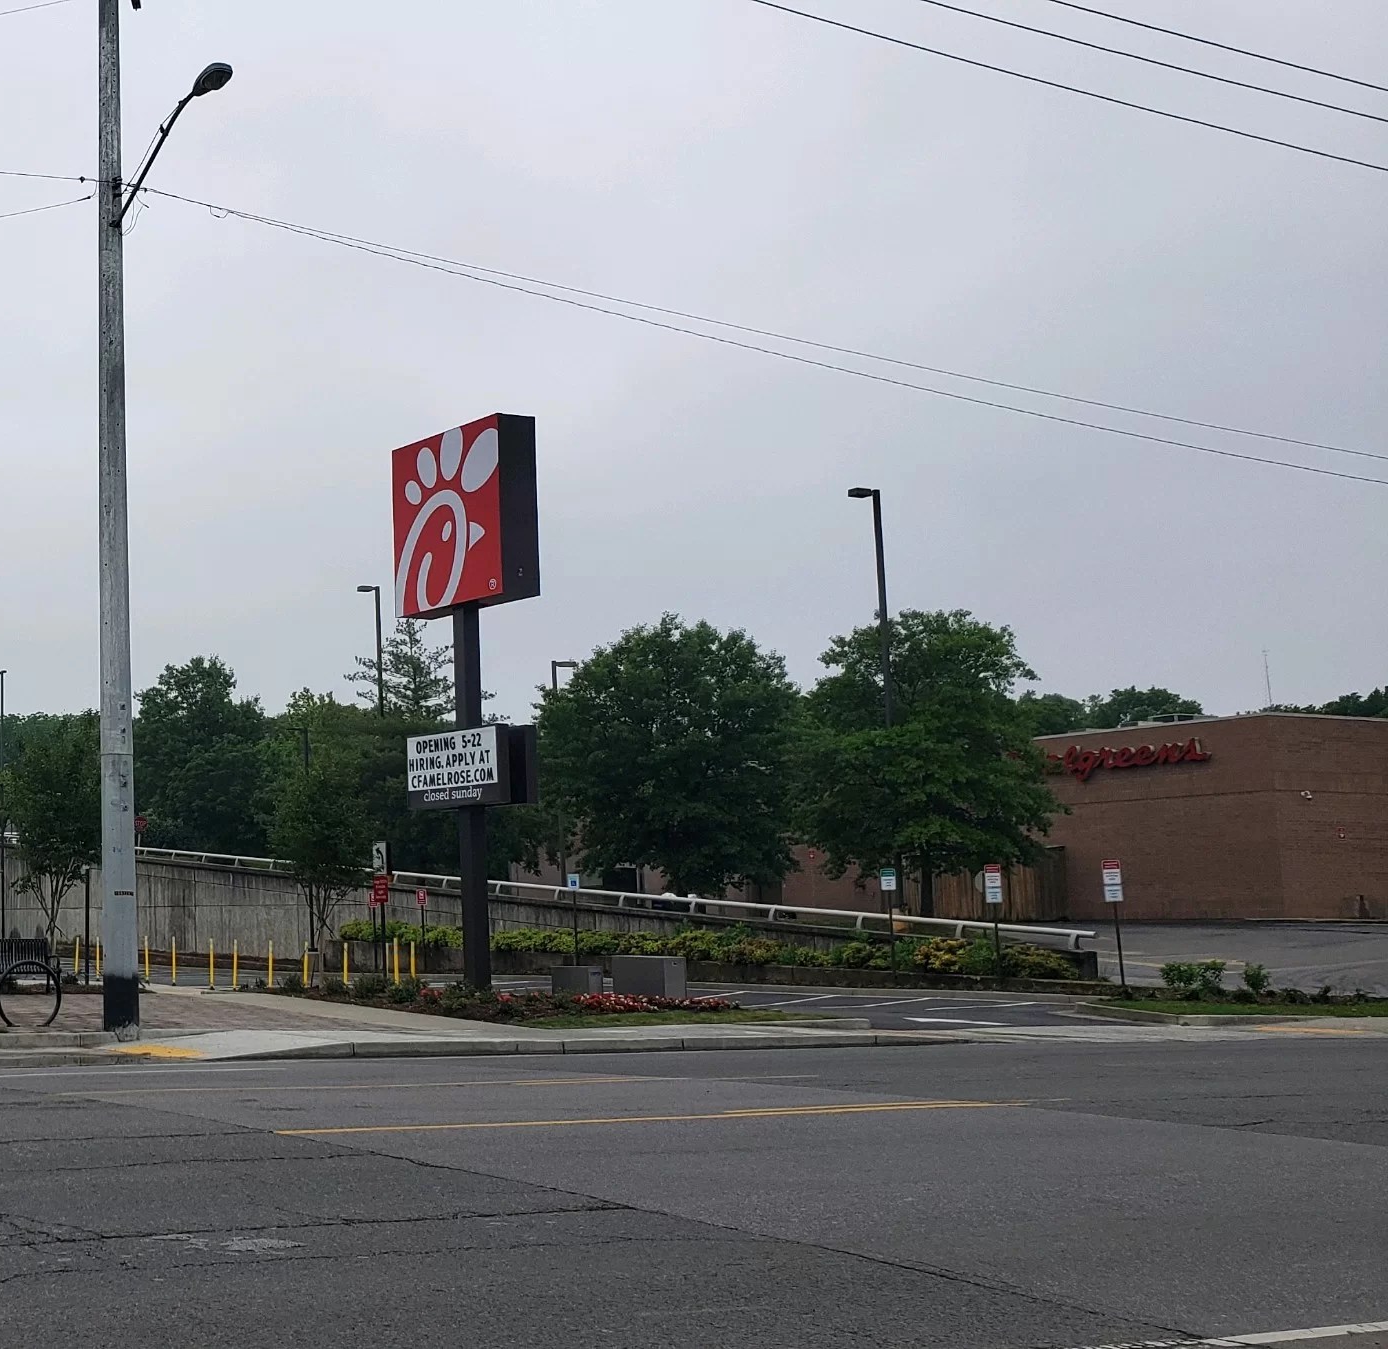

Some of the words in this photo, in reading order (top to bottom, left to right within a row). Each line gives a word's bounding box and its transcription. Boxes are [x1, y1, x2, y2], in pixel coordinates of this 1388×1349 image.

[415, 736, 456, 755] OPENING
[461, 732, 482, 749] 5-22
[408, 755, 444, 773] HIRING.
[445, 752, 475, 769] APPLY
[478, 750, 491, 765] AT
[411, 767, 495, 789] CFAMELROSE.COM
[423, 788, 450, 802] closed
[451, 786, 483, 801] sunday
